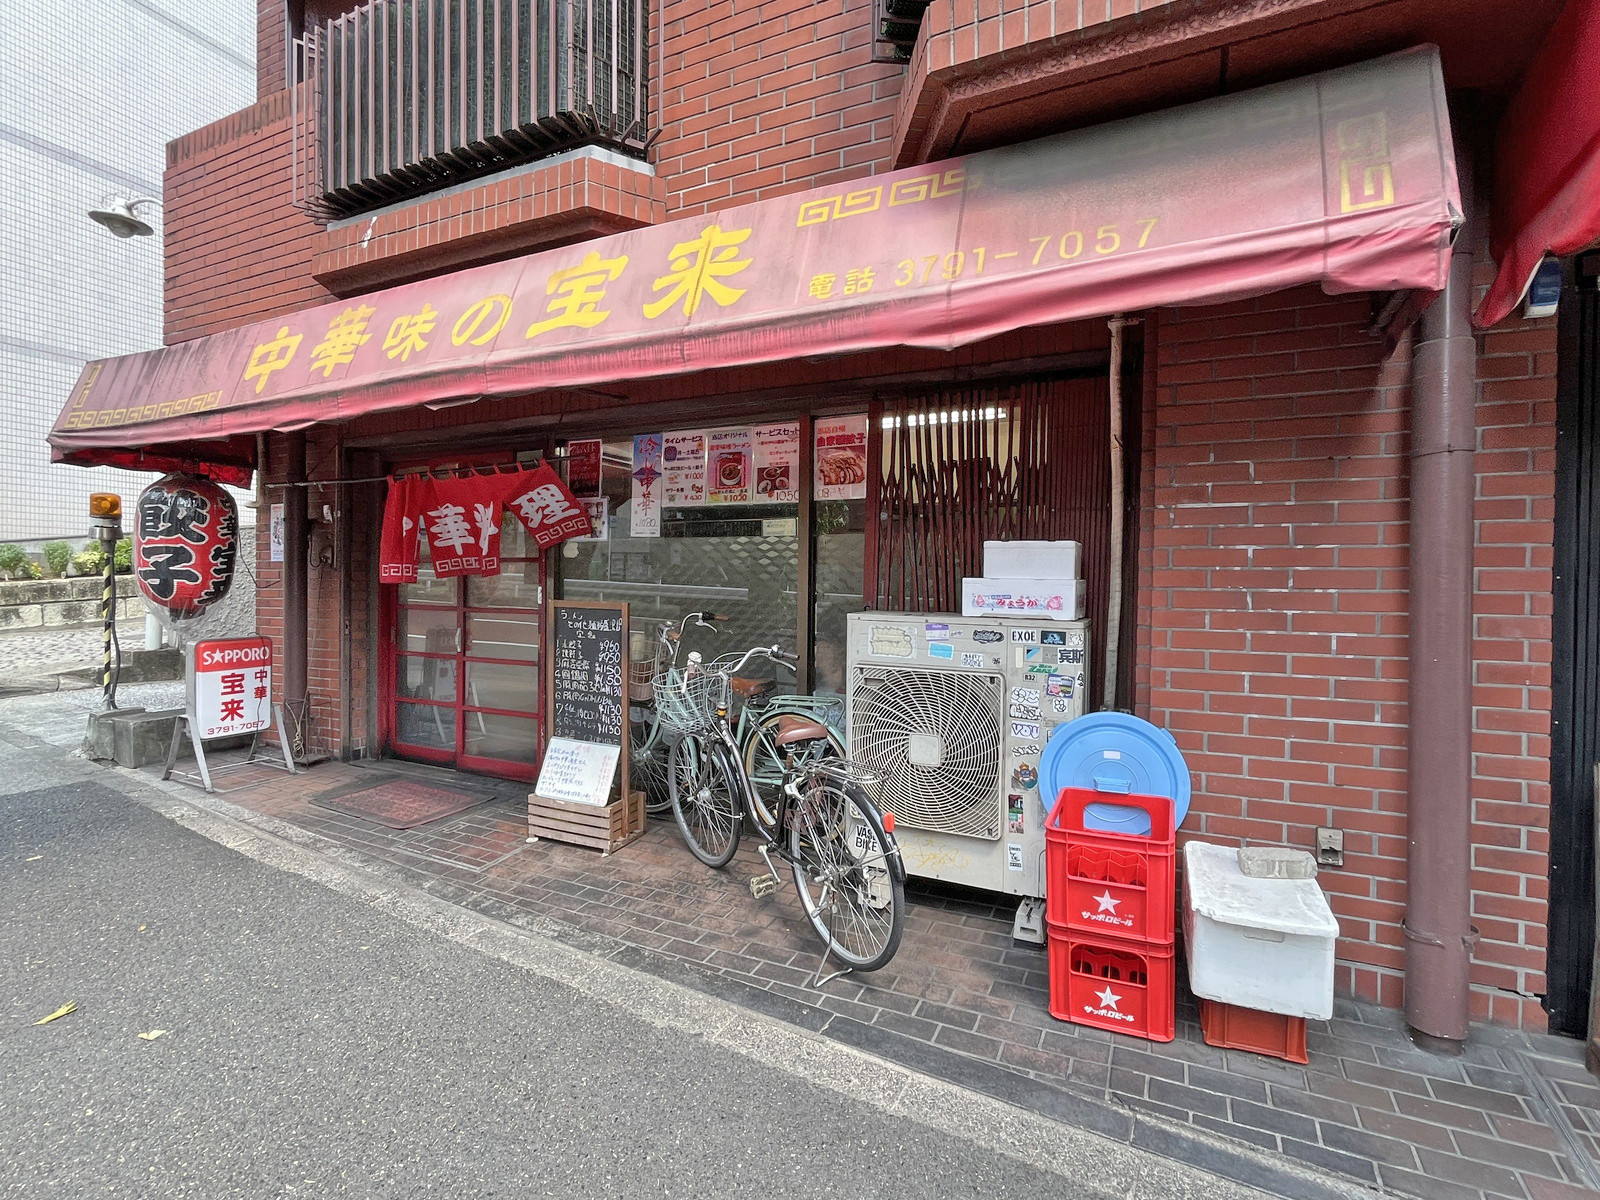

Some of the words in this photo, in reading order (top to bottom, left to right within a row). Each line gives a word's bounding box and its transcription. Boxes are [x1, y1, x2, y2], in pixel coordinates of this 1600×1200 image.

[807, 268, 877, 299] 電話
[895, 217, 1160, 287] 3791-7057
[243, 224, 754, 394] 中華味の宝来
[664, 435, 704, 445] タイムサービス
[139, 487, 210, 600] 餃子
[1012, 630, 1036, 642] EXOE
[254, 669, 269, 700] 中華
[220, 672, 246, 722] 宝来
[207, 719, 266, 736] 3791-7057
[856, 825, 877, 841] VAS
[1081, 911, 1133, 926] サッポロビール
[1084, 1005, 1134, 1021] サッポロビール
